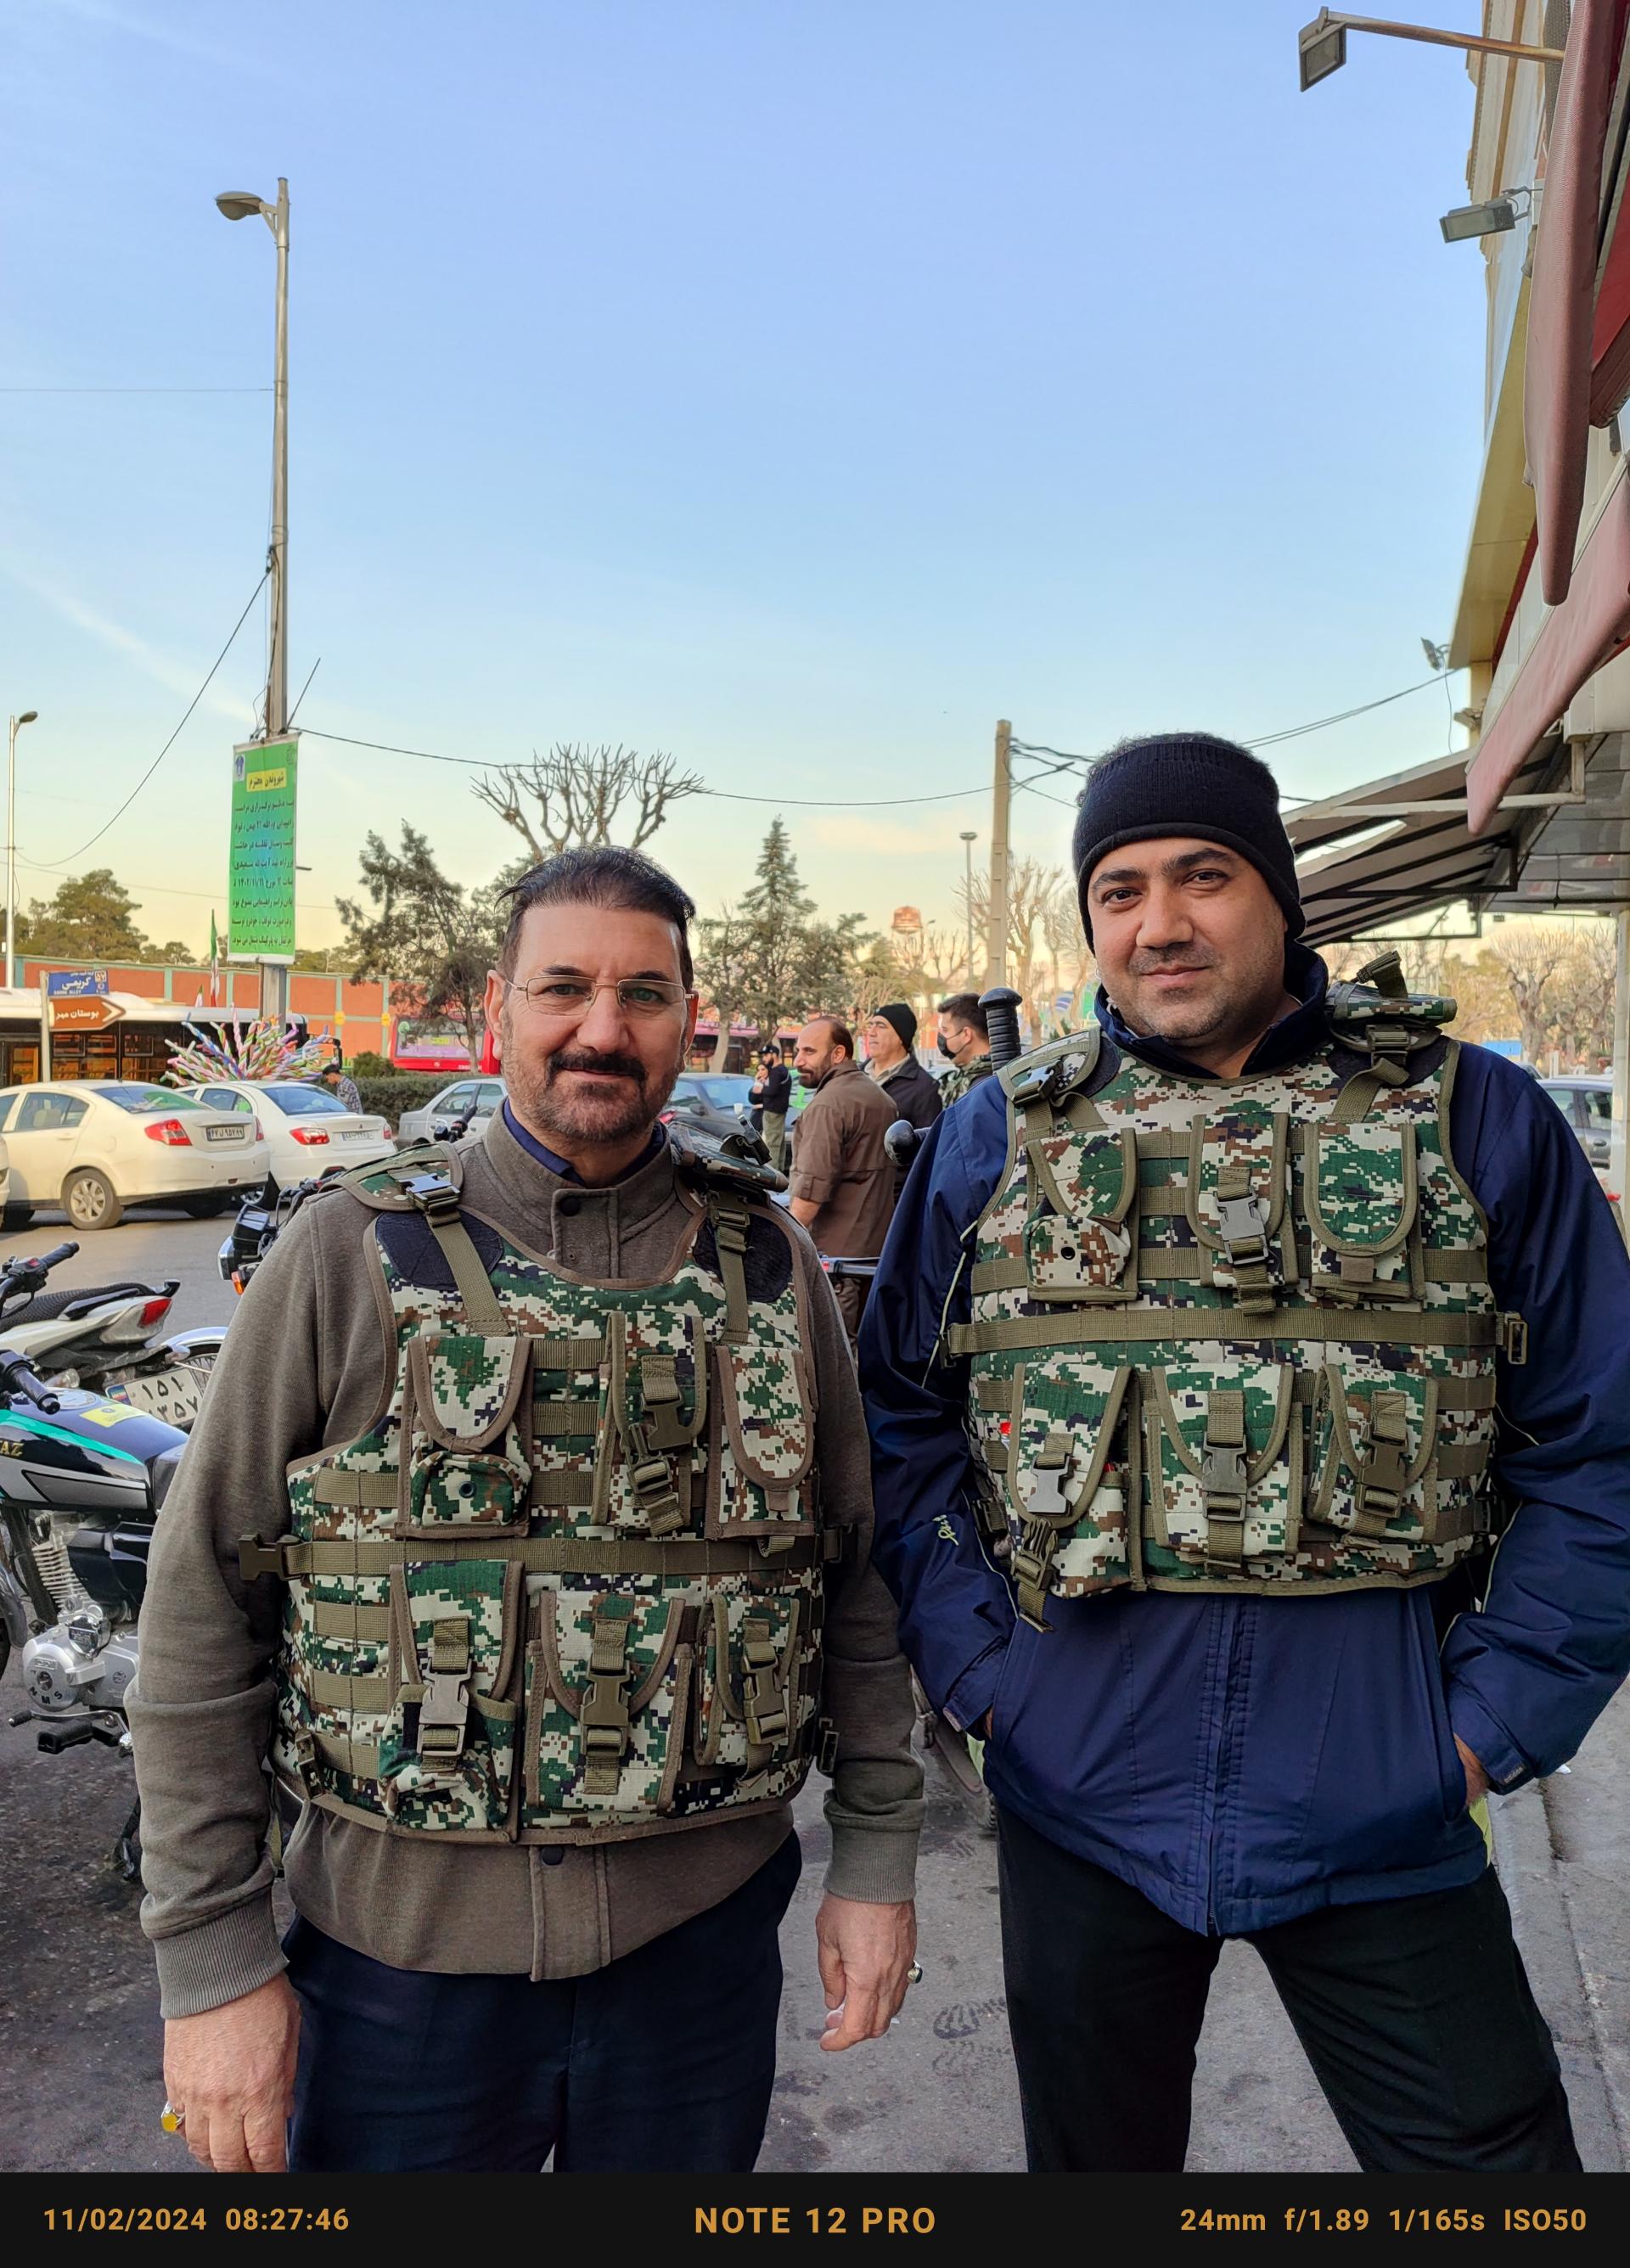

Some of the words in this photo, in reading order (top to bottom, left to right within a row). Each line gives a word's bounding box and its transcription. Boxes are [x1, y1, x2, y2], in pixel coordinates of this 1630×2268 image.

[61, 976, 91, 990] کریمی
[55, 1010, 70, 1020] مهر
[70, 1009, 99, 1020] بوستان
